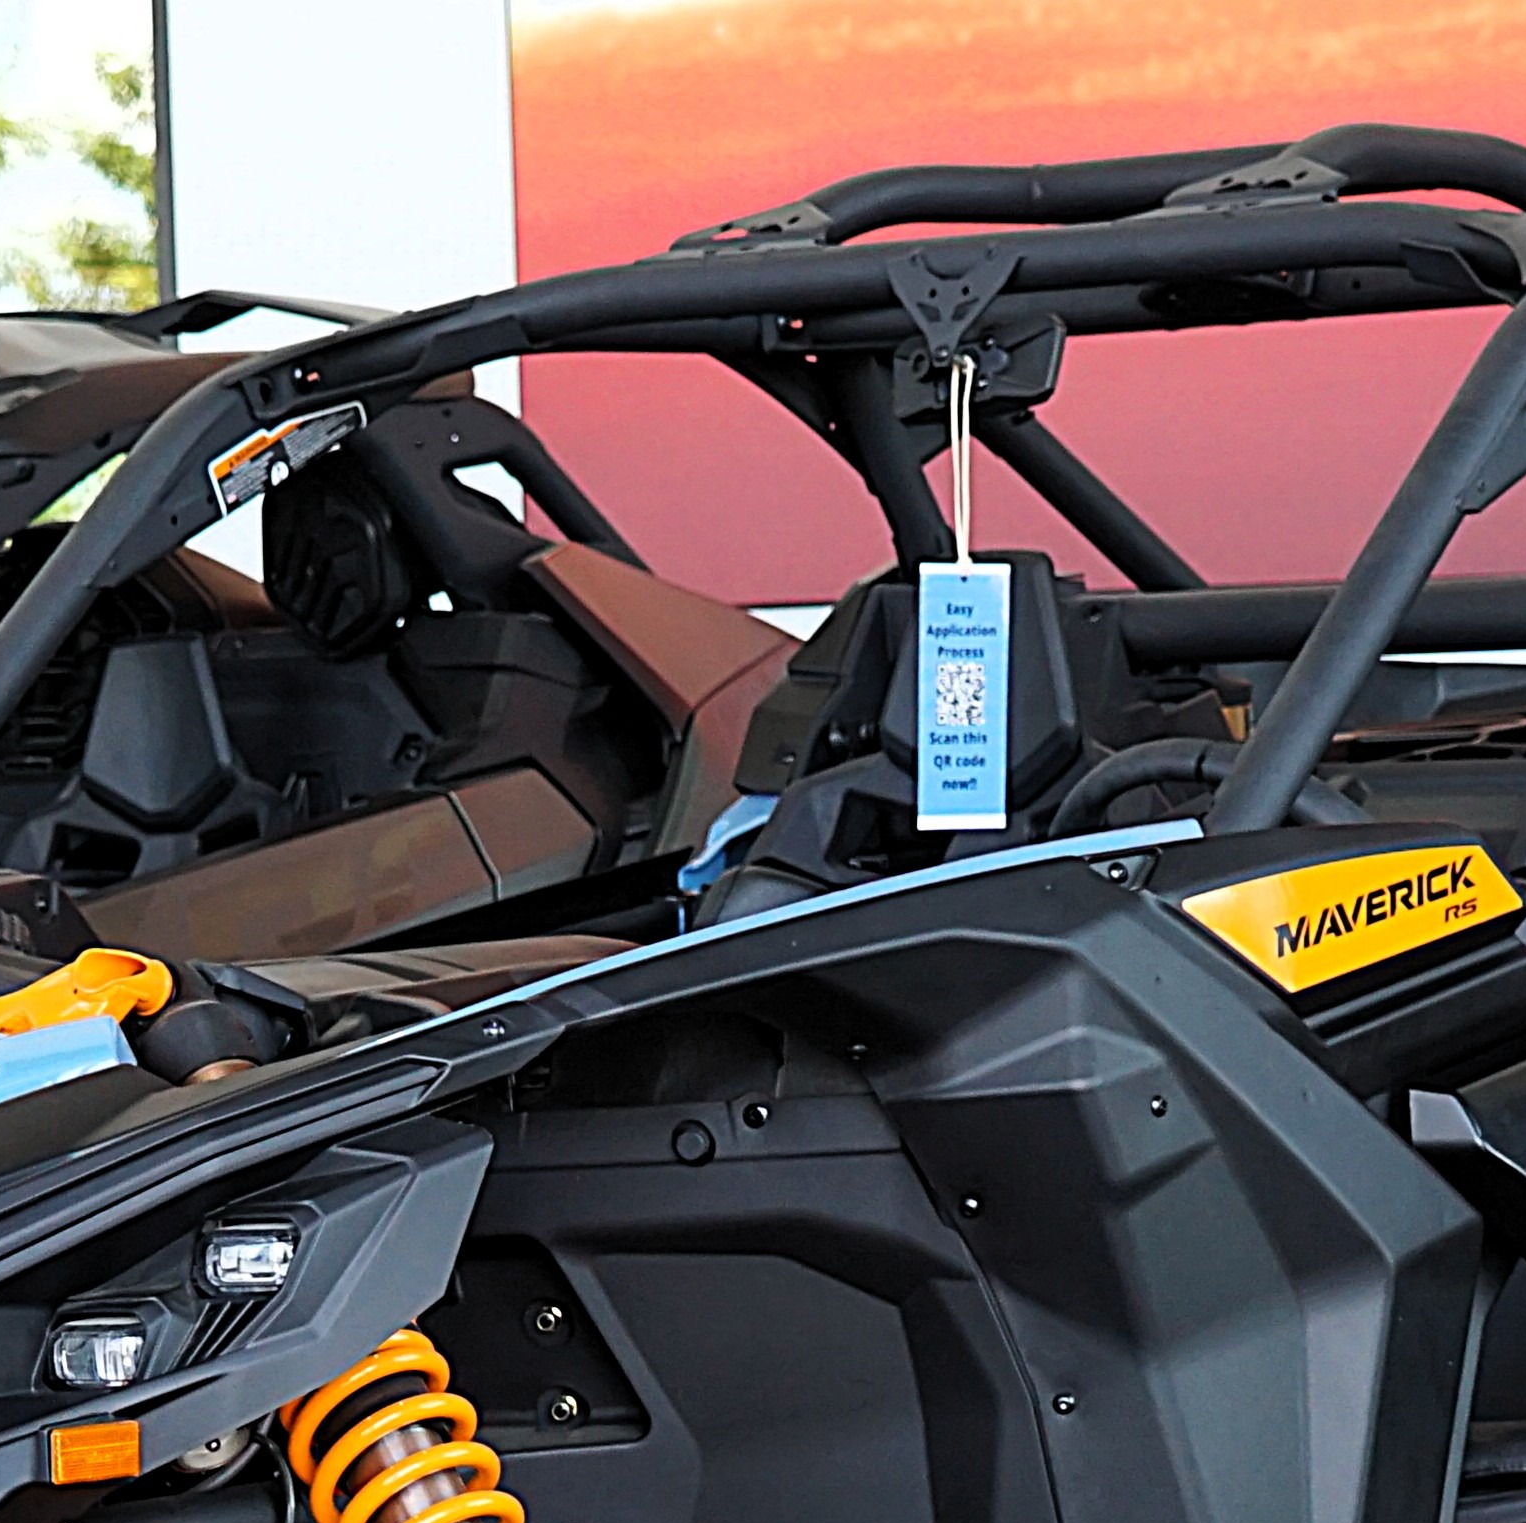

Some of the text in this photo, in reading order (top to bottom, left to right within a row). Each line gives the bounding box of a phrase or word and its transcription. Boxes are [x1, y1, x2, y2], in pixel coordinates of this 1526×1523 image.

[946, 602, 974, 618] Easy
[926, 623, 997, 639] Application
[937, 646, 984, 658] Process
[929, 732, 987, 745] Scan this
[933, 754, 986, 771] QR code
[1273, 855, 1476, 959] MAVERICK
[1443, 898, 1478, 923] RS
